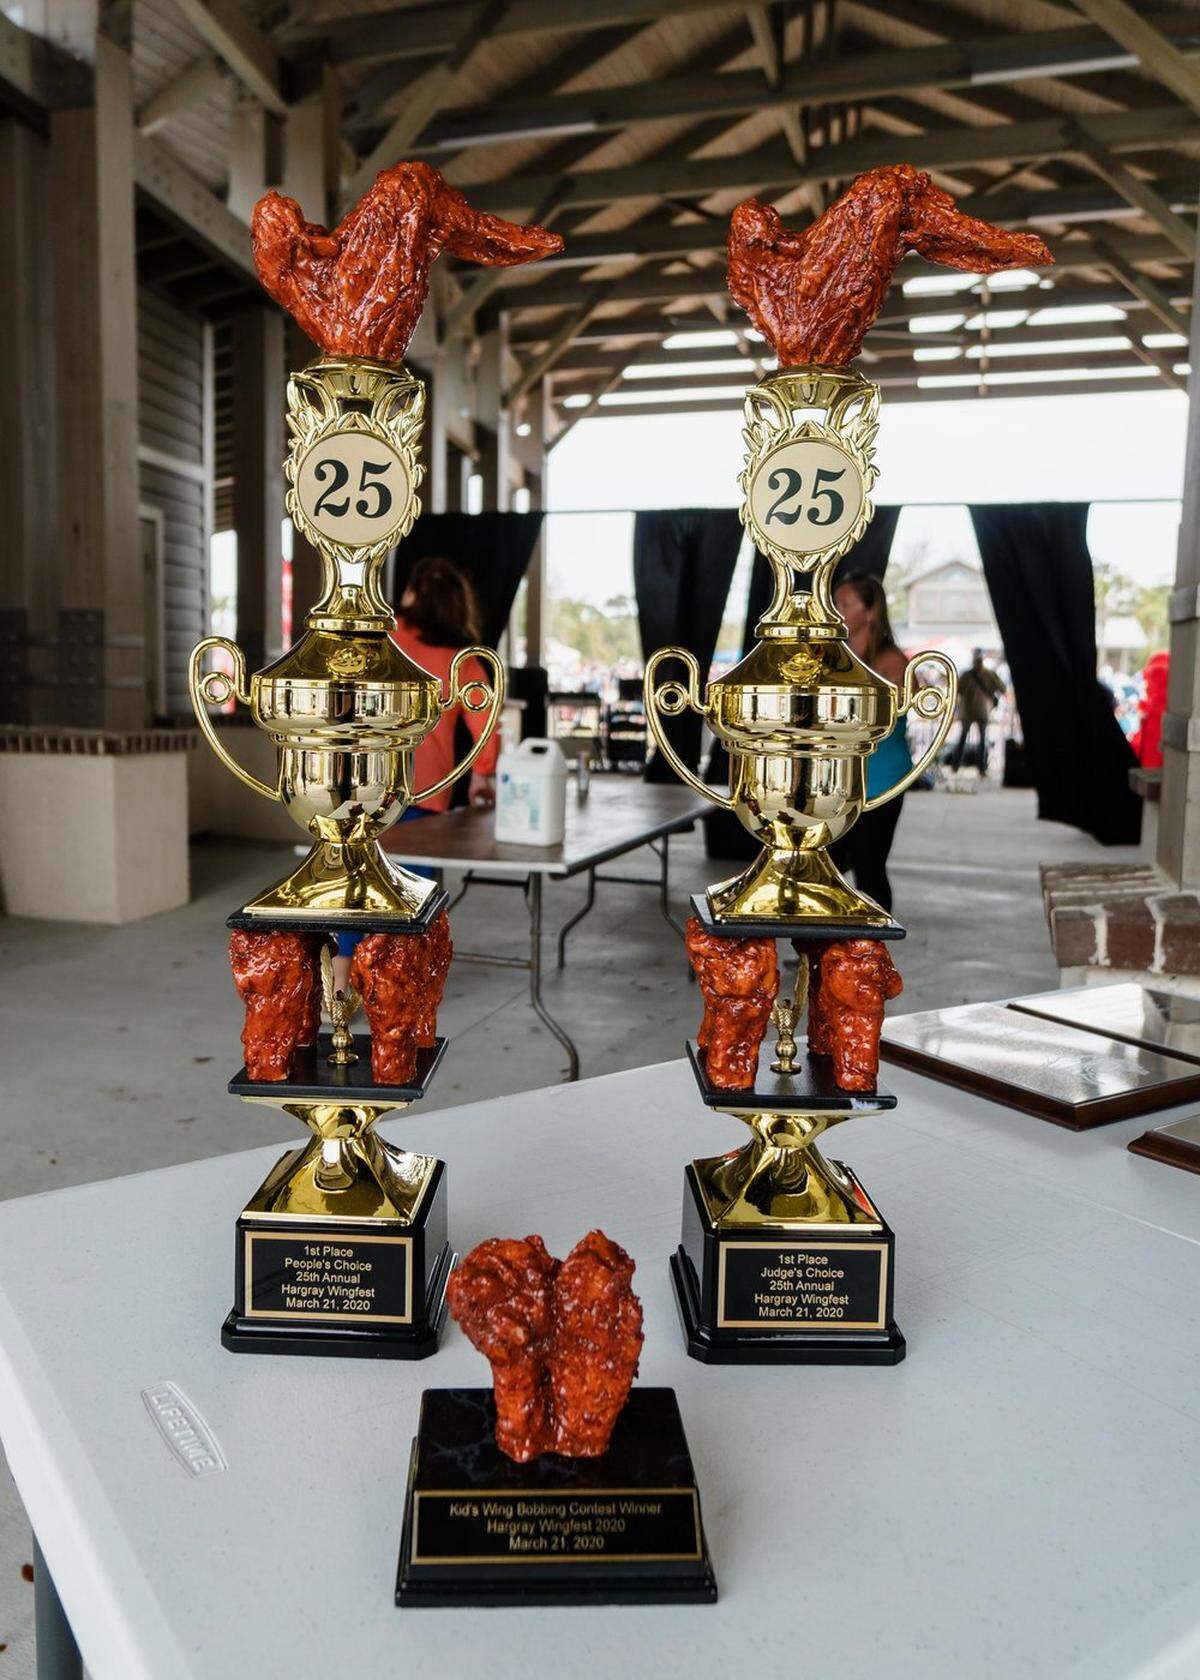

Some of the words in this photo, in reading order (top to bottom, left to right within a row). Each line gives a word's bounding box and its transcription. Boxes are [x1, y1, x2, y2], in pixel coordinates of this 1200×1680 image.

[313, 459, 393, 519] 25
[765, 467, 847, 526] 25
[304, 1245, 320, 1256] 1st
[323, 1246, 354, 1257] Place
[285, 1258, 331, 1271] People's
[334, 1260, 372, 1271] Choice
[778, 1254, 795, 1265] 1st
[797, 1254, 829, 1265] Place
[296, 1271, 320, 1283] 25th
[322, 1272, 361, 1284] Annual
[760, 1268, 803, 1280] Judge's
[806, 1268, 845, 1279] Choice
[281, 1284, 325, 1297] Hargray
[327, 1286, 376, 1299] Wingfest
[769, 1281, 794, 1292] 25th
[795, 1281, 835, 1292] Annual
[286, 1297, 320, 1309] March
[323, 1299, 340, 1311] 21,
[343, 1300, 371, 1311] 2020
[754, 1293, 798, 1306] Hargray
[801, 1294, 849, 1307] Wingfest
[758, 1307, 793, 1318] March
[795, 1308, 813, 1320] 21,
[817, 1308, 844, 1318] 2020
[151, 1392, 215, 1472] LIFETIME
[449, 1502, 480, 1518] Kid's
[483, 1503, 514, 1519] Wing
[516, 1503, 567, 1518] Bobbing
[569, 1503, 617, 1515] Contest
[619, 1502, 662, 1514] Winner
[486, 1520, 536, 1536] Hargray
[539, 1519, 593, 1534] Wingfest
[595, 1519, 627, 1532] 2020
[508, 1537, 548, 1550] March
[573, 1536, 605, 1550] 2020
